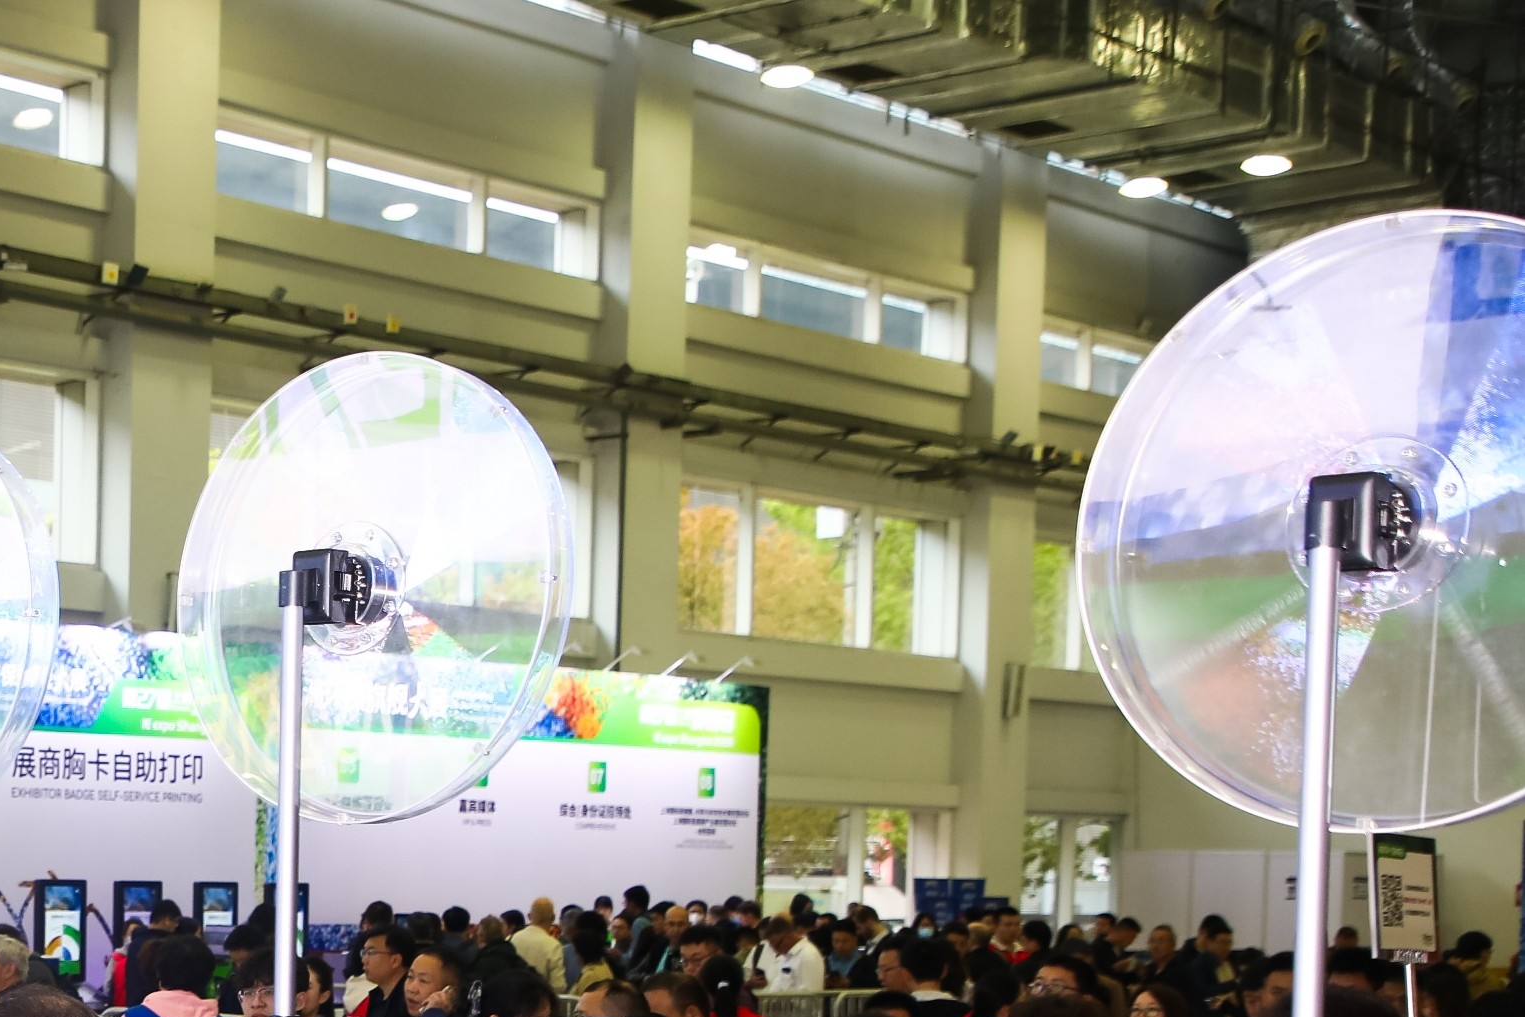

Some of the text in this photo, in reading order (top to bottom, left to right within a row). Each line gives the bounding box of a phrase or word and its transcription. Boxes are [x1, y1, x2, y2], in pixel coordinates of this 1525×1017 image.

[11, 746, 203, 786] 展商胸卡自助打印
[11, 787, 203, 804] EXHIBITOR BADGE SELF-SERVICE PRINTING
